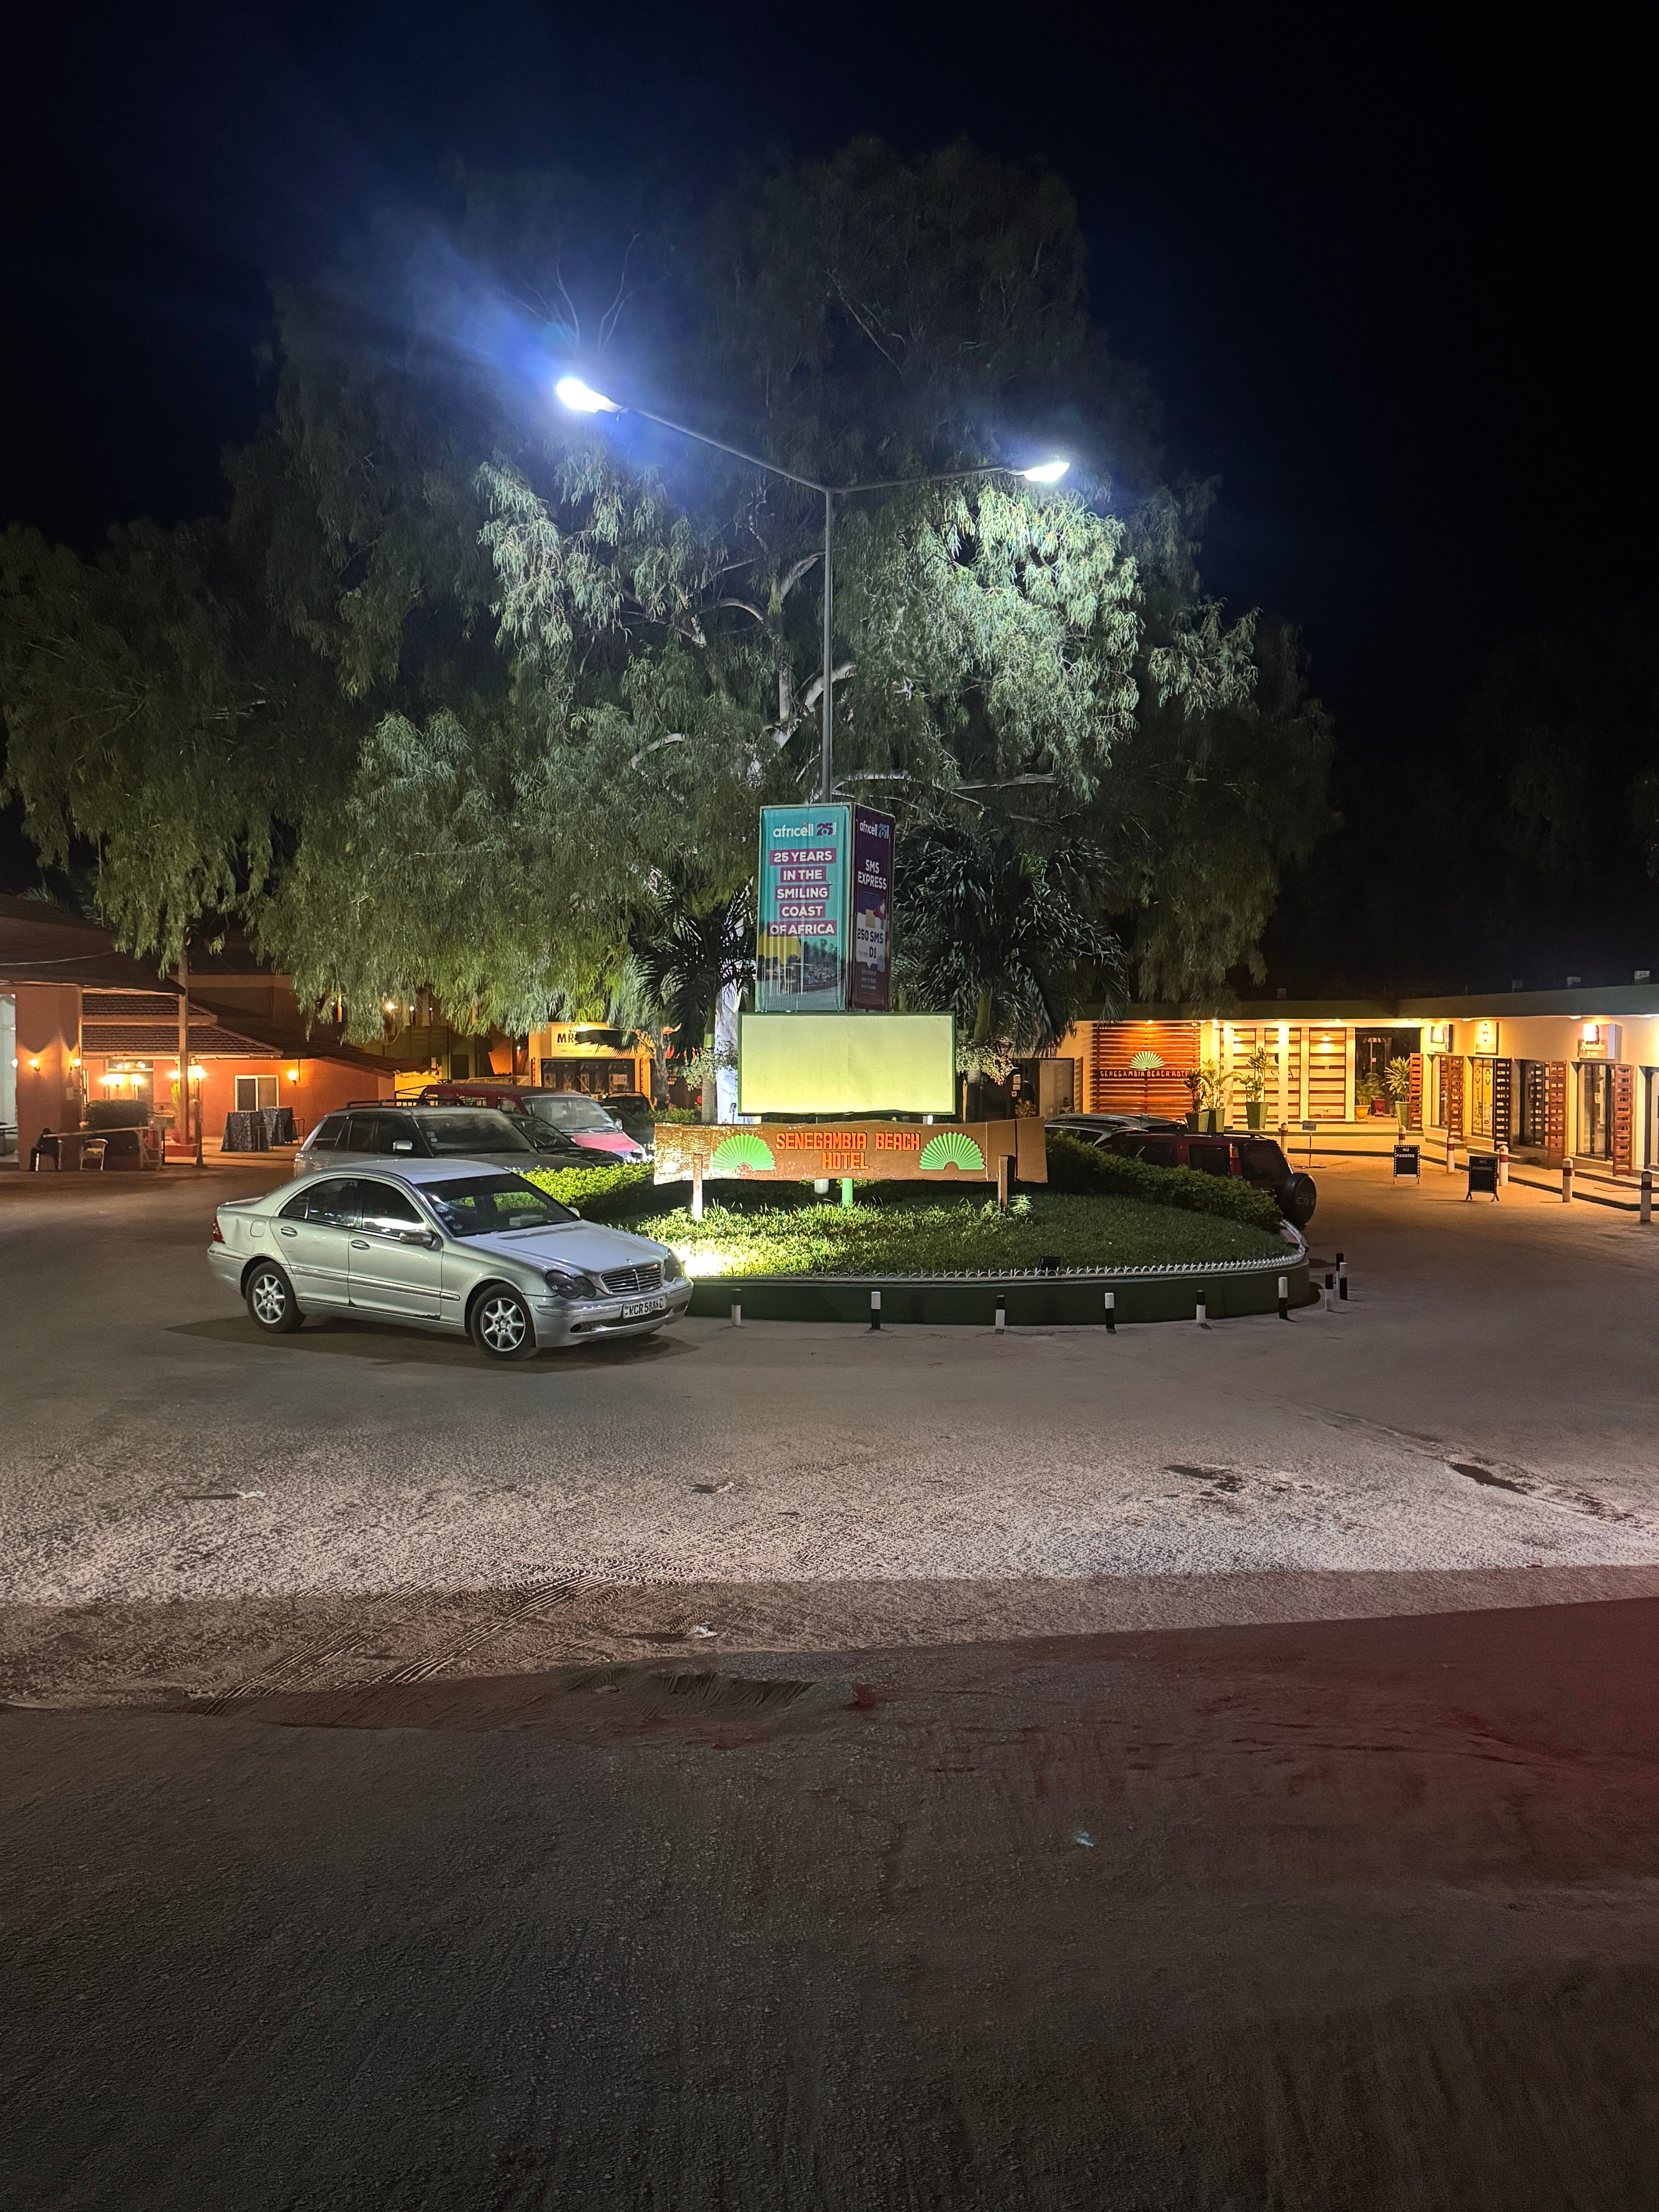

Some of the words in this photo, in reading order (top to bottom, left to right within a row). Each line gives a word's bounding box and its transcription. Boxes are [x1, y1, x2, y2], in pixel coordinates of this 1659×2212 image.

[773, 823, 814, 838] africell
[774, 852, 789, 862] 25
[791, 851, 832, 862] YEARS
[866, 859, 879, 874] SMS
[783, 870, 796, 880] IN
[798, 869, 823, 880] THE
[858, 871, 887, 890] EXPRESS
[777, 887, 828, 899] SMILING
[781, 906, 823, 917] COAST
[770, 924, 787, 935] OF
[788, 924, 835, 934] AFRICA
[857, 928, 869, 941] 250
[870, 931, 883, 944] SMS
[869, 946, 877, 958] D1
[775, 1132, 867, 1150] SENEGAMBIA
[875, 1132, 921, 1151] BEACH
[821, 1152, 870, 1170] HOTEL
[629, 1303, 643, 1316] KCR
